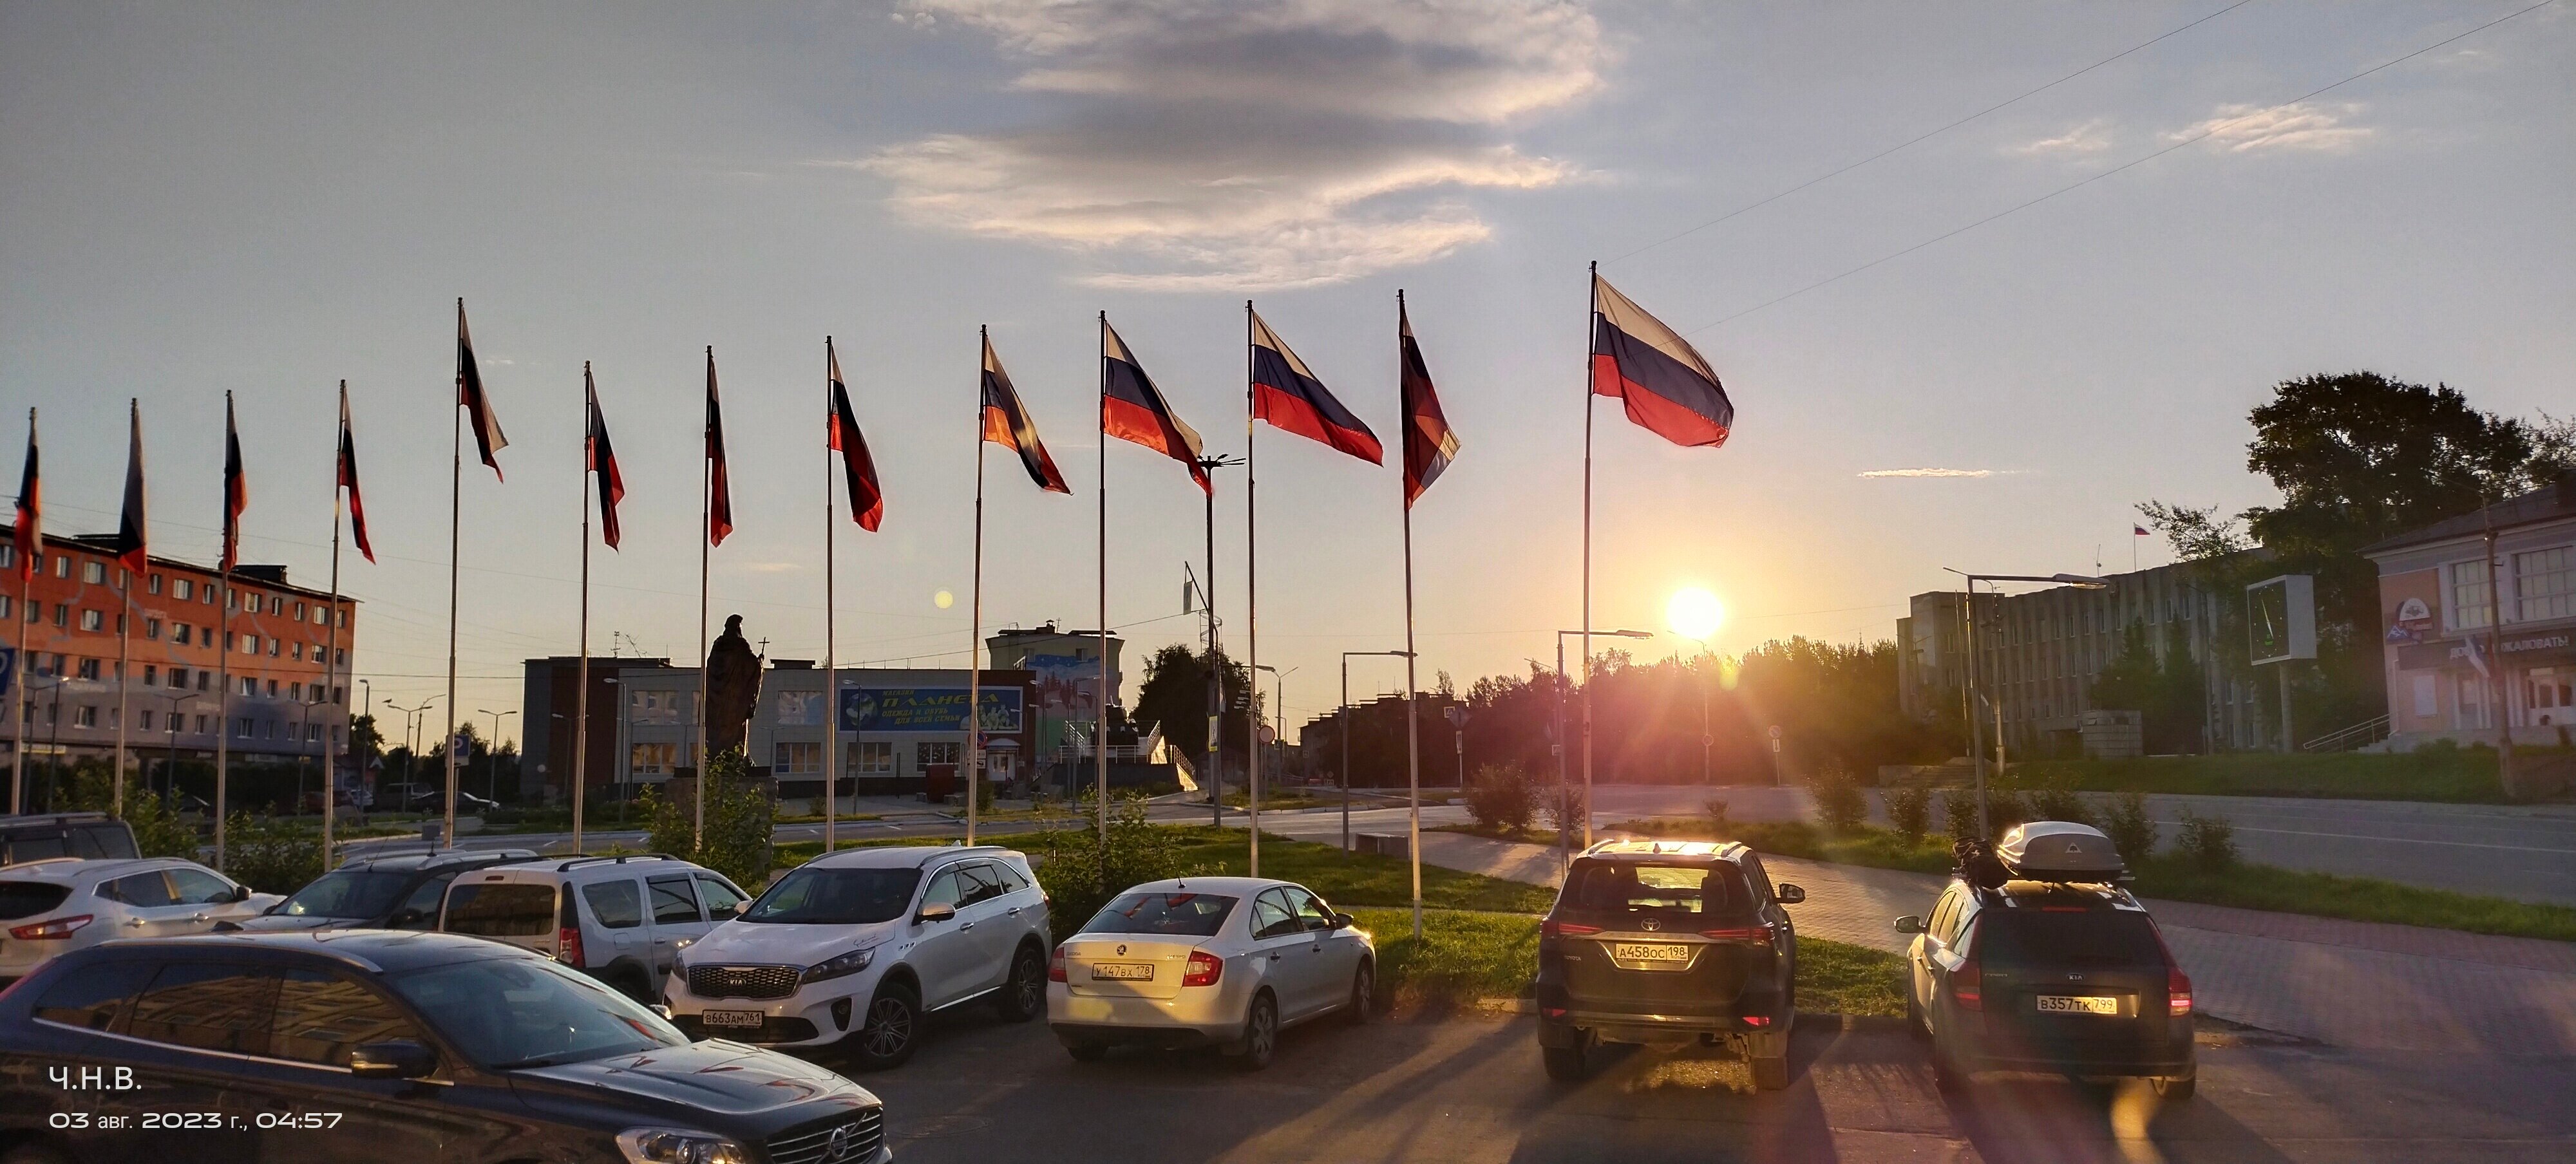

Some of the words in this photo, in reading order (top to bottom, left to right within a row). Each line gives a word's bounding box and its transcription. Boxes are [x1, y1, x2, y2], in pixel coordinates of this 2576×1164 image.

[2494, 636, 2570, 653] ЖАЛОВАТЬ!
[924, 708, 948, 716] ОБУВЬ
[1619, 946, 1665, 958] А458ОС
[1667, 946, 1685, 956] 198
[1096, 966, 1133, 977] У147ВХ
[1135, 966, 1150, 975] 178
[2041, 997, 2090, 1011] В357ТК
[2093, 999, 2113, 1009] 799
[706, 1013, 744, 1024] В663АМ
[744, 1013, 760, 1022] 761
